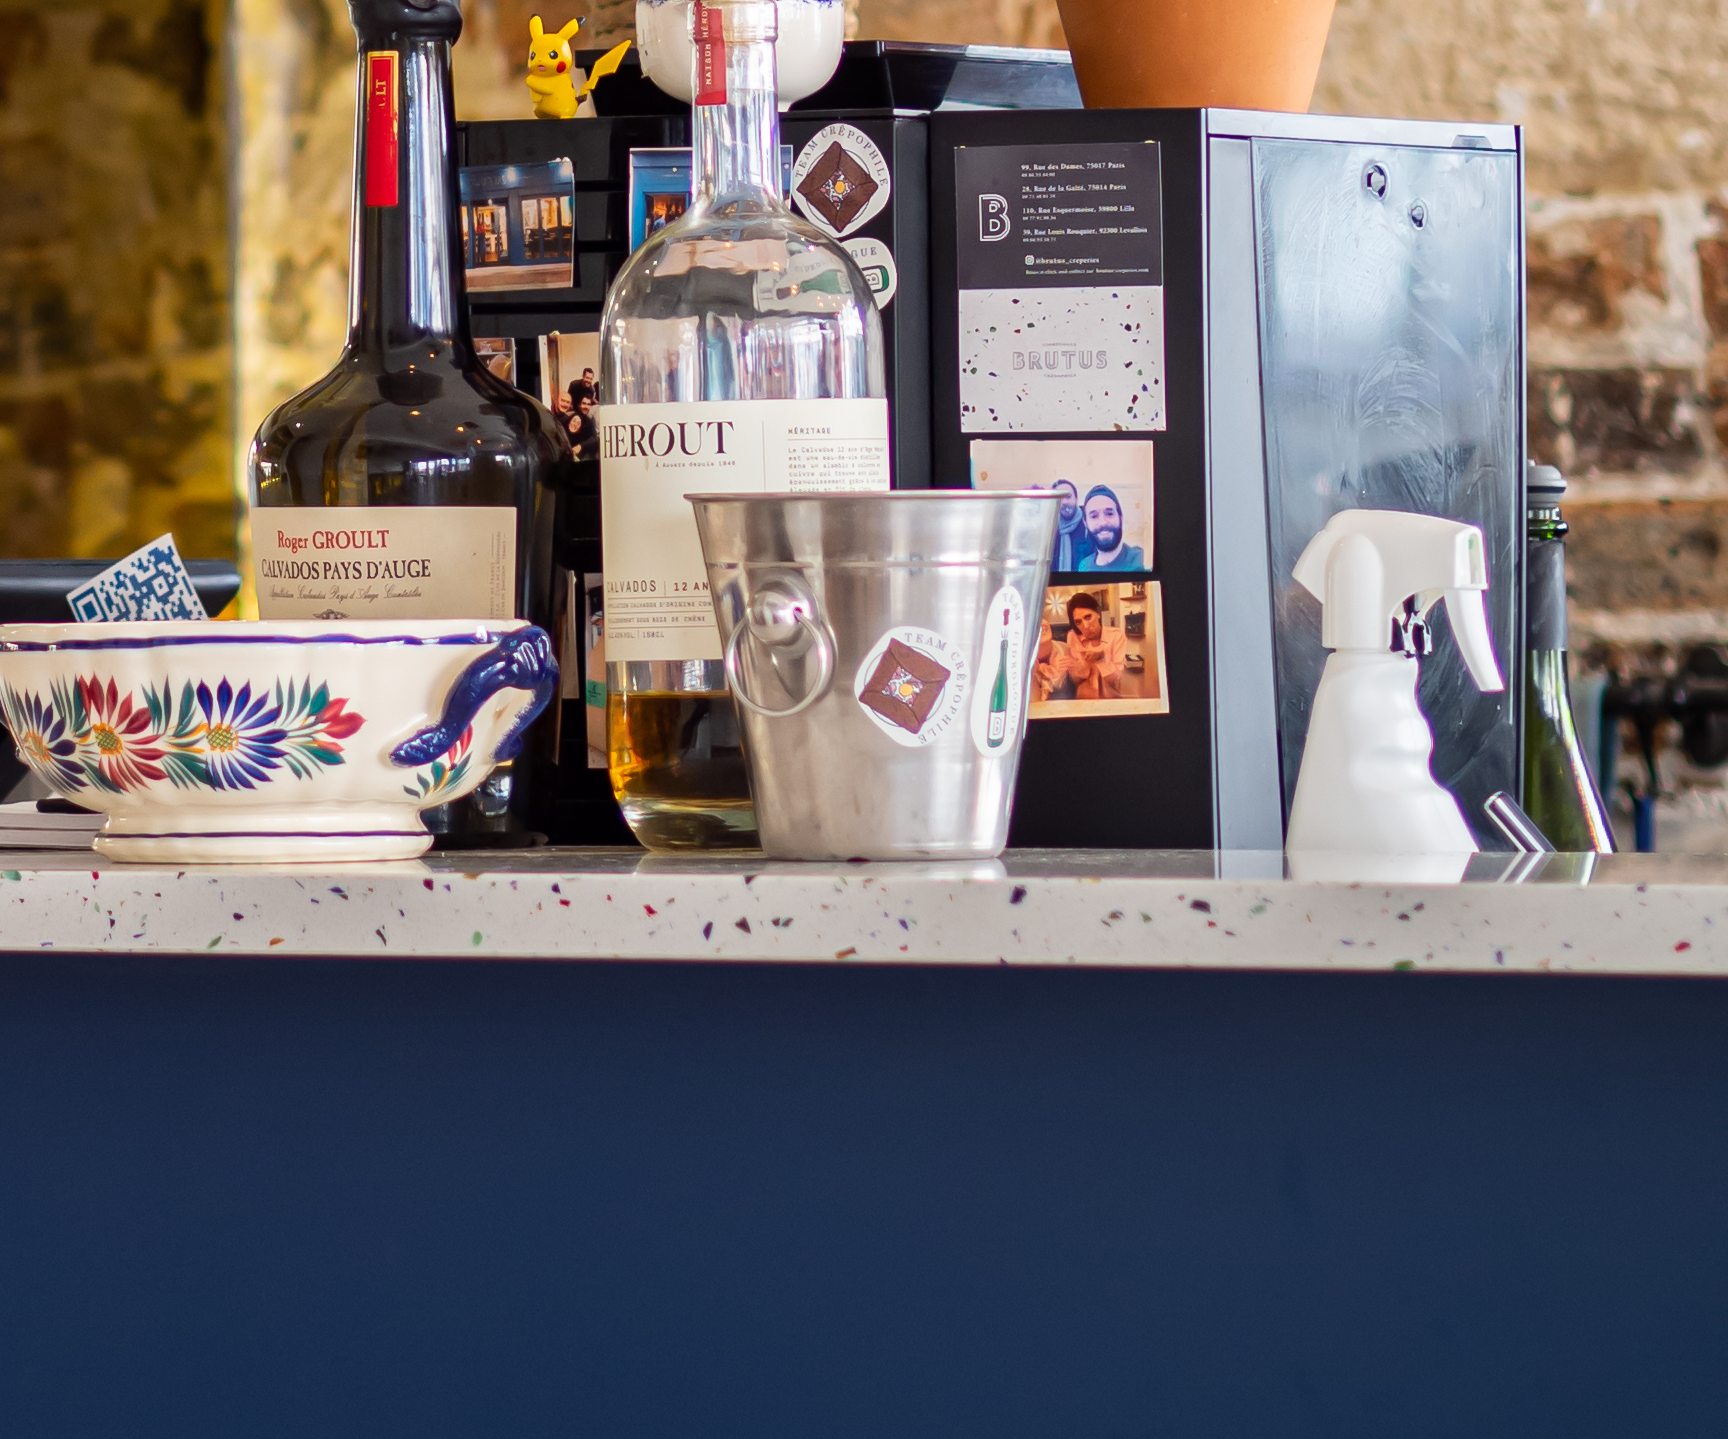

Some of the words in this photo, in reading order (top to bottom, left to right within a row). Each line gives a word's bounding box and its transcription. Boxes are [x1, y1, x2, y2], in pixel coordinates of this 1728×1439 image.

[704, 43, 712, 86] MAISON
[794, 141, 819, 178] TEAM
[979, 194, 1011, 242] B
[1012, 350, 1108, 370] BRUTUS
[603, 421, 735, 459] HEROUT
[277, 530, 309, 554] Roger
[312, 529, 390, 550] GROULT
[261, 558, 320, 580] CALVADOS
[323, 560, 363, 580] PAYS
[366, 558, 432, 579] D'AUGE
[674, 582, 688, 592] 12
[693, 582, 709, 591] AN
[904, 632, 947, 651] TEAM
